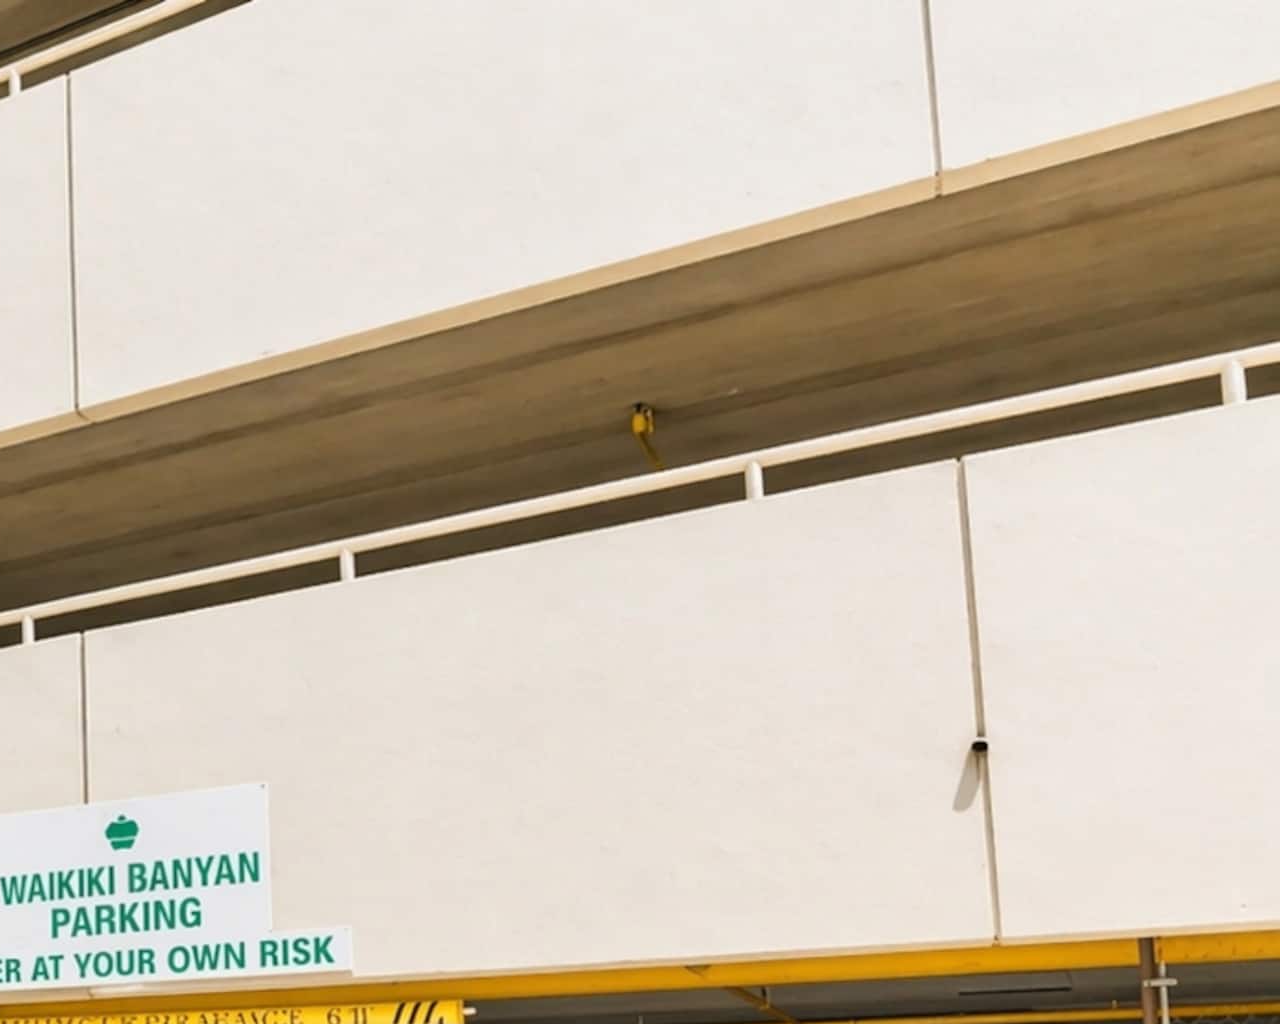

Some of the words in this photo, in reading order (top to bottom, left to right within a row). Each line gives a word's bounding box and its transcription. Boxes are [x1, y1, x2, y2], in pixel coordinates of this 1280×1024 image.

[0, 865, 117, 906] WAIKIKI
[127, 851, 262, 894] BANYAN
[49, 896, 203, 940] PARKING
[30, 952, 65, 981] AT
[75, 947, 157, 978] YOUR
[166, 941, 247, 975] OWN
[258, 935, 336, 968] RISK
